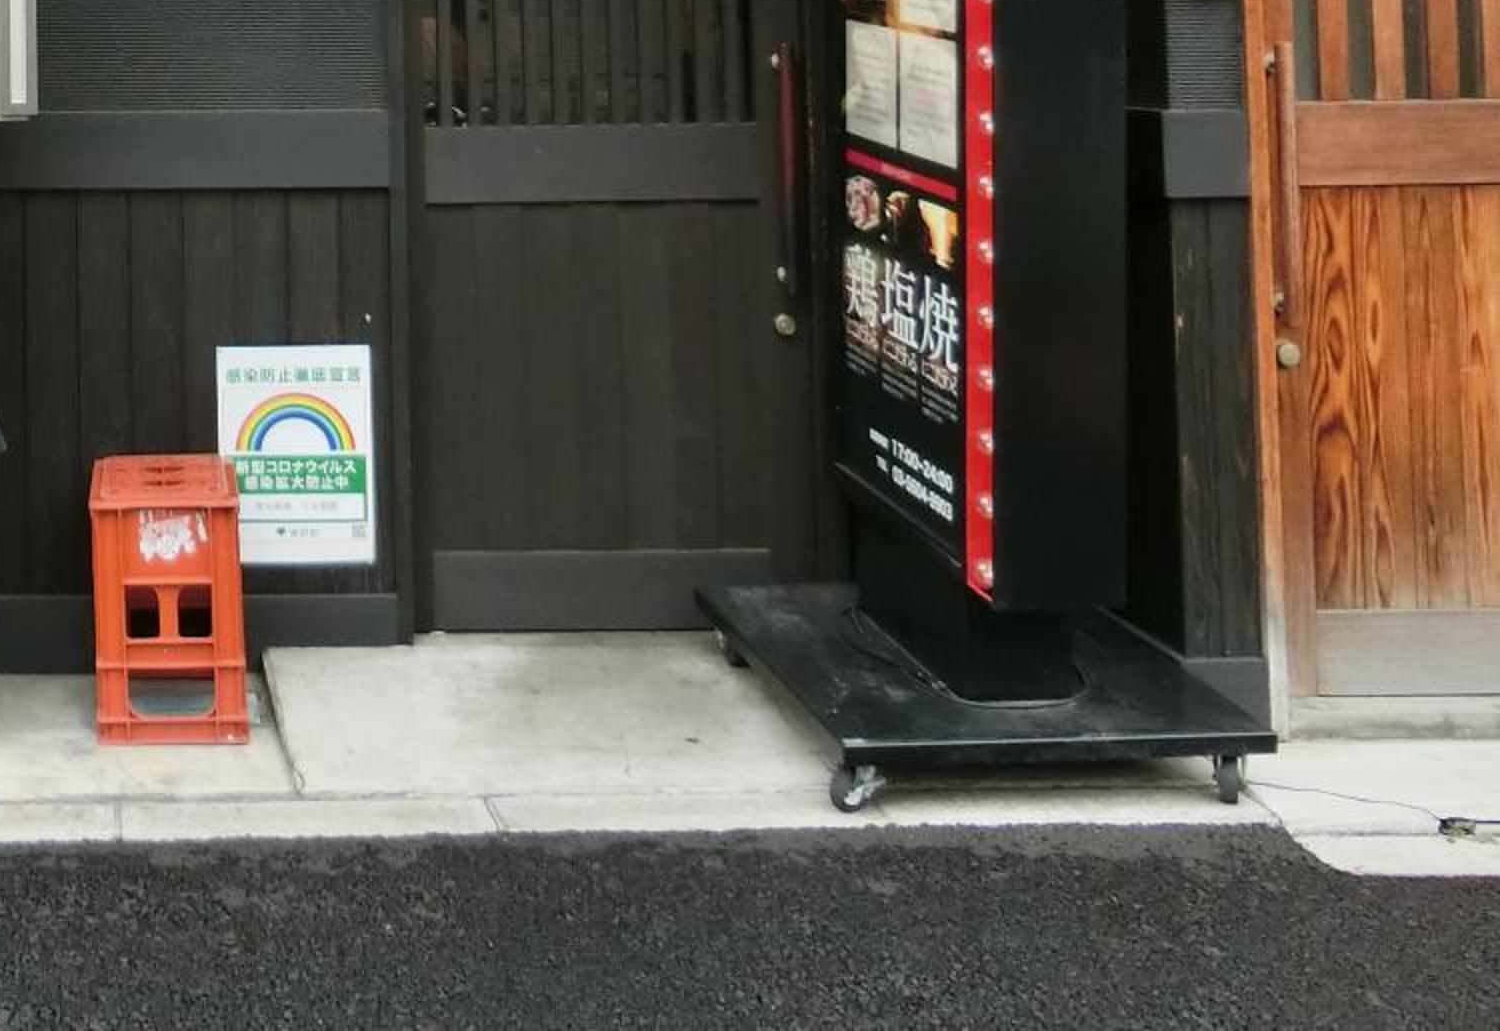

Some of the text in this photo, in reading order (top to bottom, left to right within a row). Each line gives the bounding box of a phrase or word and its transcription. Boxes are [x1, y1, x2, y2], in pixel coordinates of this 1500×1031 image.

[226, 367, 361, 383] 感染防止徹底宣言
[235, 460, 357, 474] 新型コロナウイルス
[243, 475, 349, 490] 感染拡大防止中
